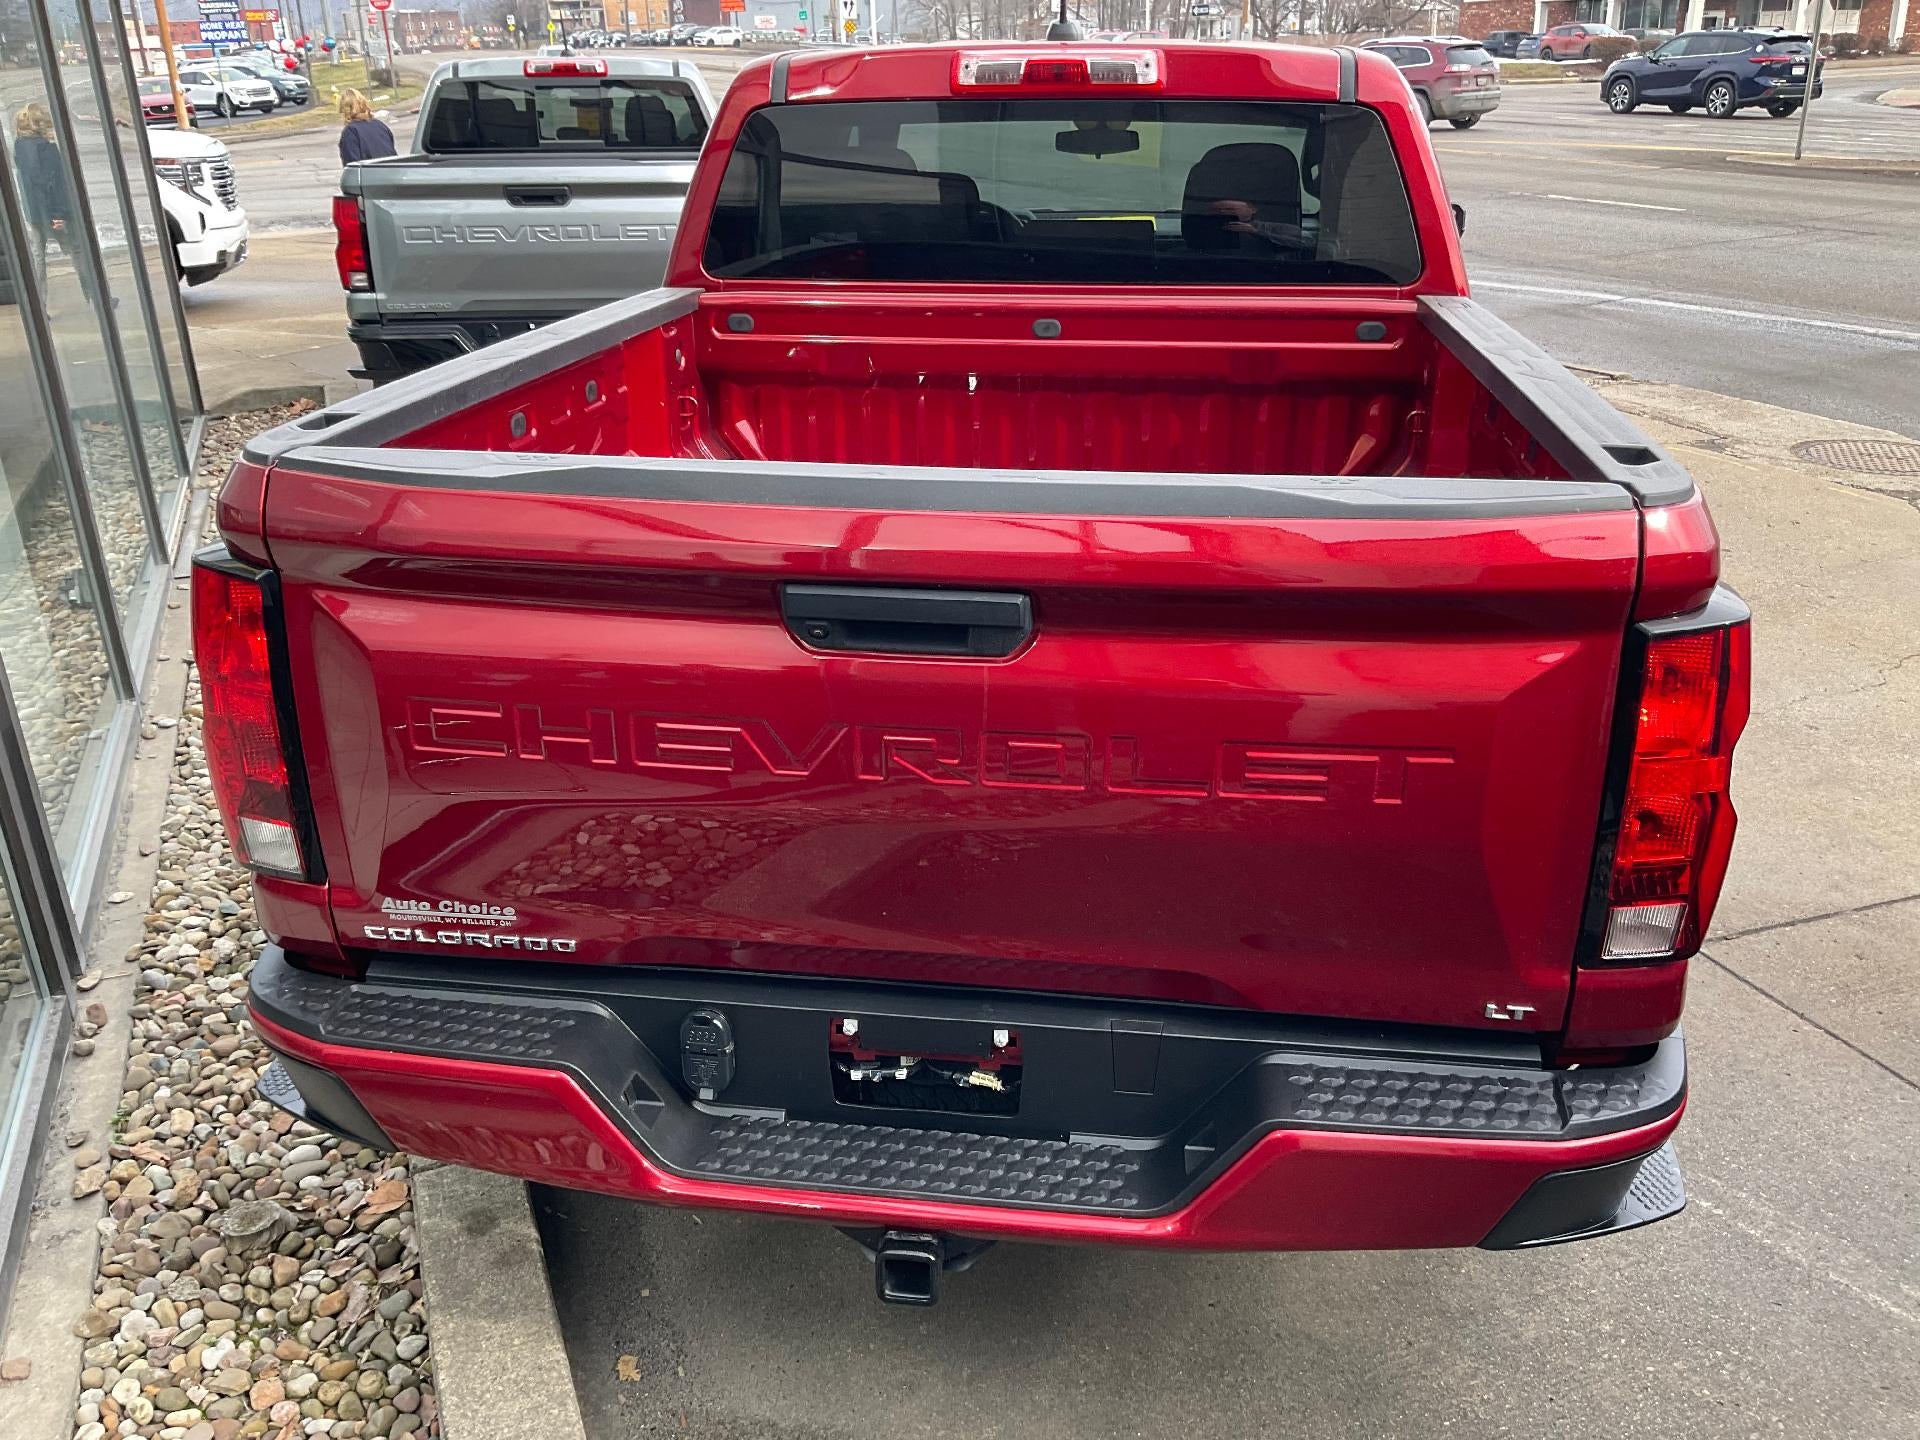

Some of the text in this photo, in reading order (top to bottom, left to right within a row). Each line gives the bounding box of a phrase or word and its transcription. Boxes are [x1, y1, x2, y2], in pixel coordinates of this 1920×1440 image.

[199, 20, 246, 31] HOME HEAT
[200, 30, 249, 40] PROPANE
[402, 224, 677, 244] CHEVROLET
[385, 302, 453, 311] COLORADO
[406, 696, 1455, 804] CHEVROLET
[381, 896, 516, 917] Auto Choice
[445, 916, 458, 925] WV
[500, 919, 513, 928] OH
[363, 925, 578, 953] COLORADO
[1484, 1003, 1537, 1021] LT
